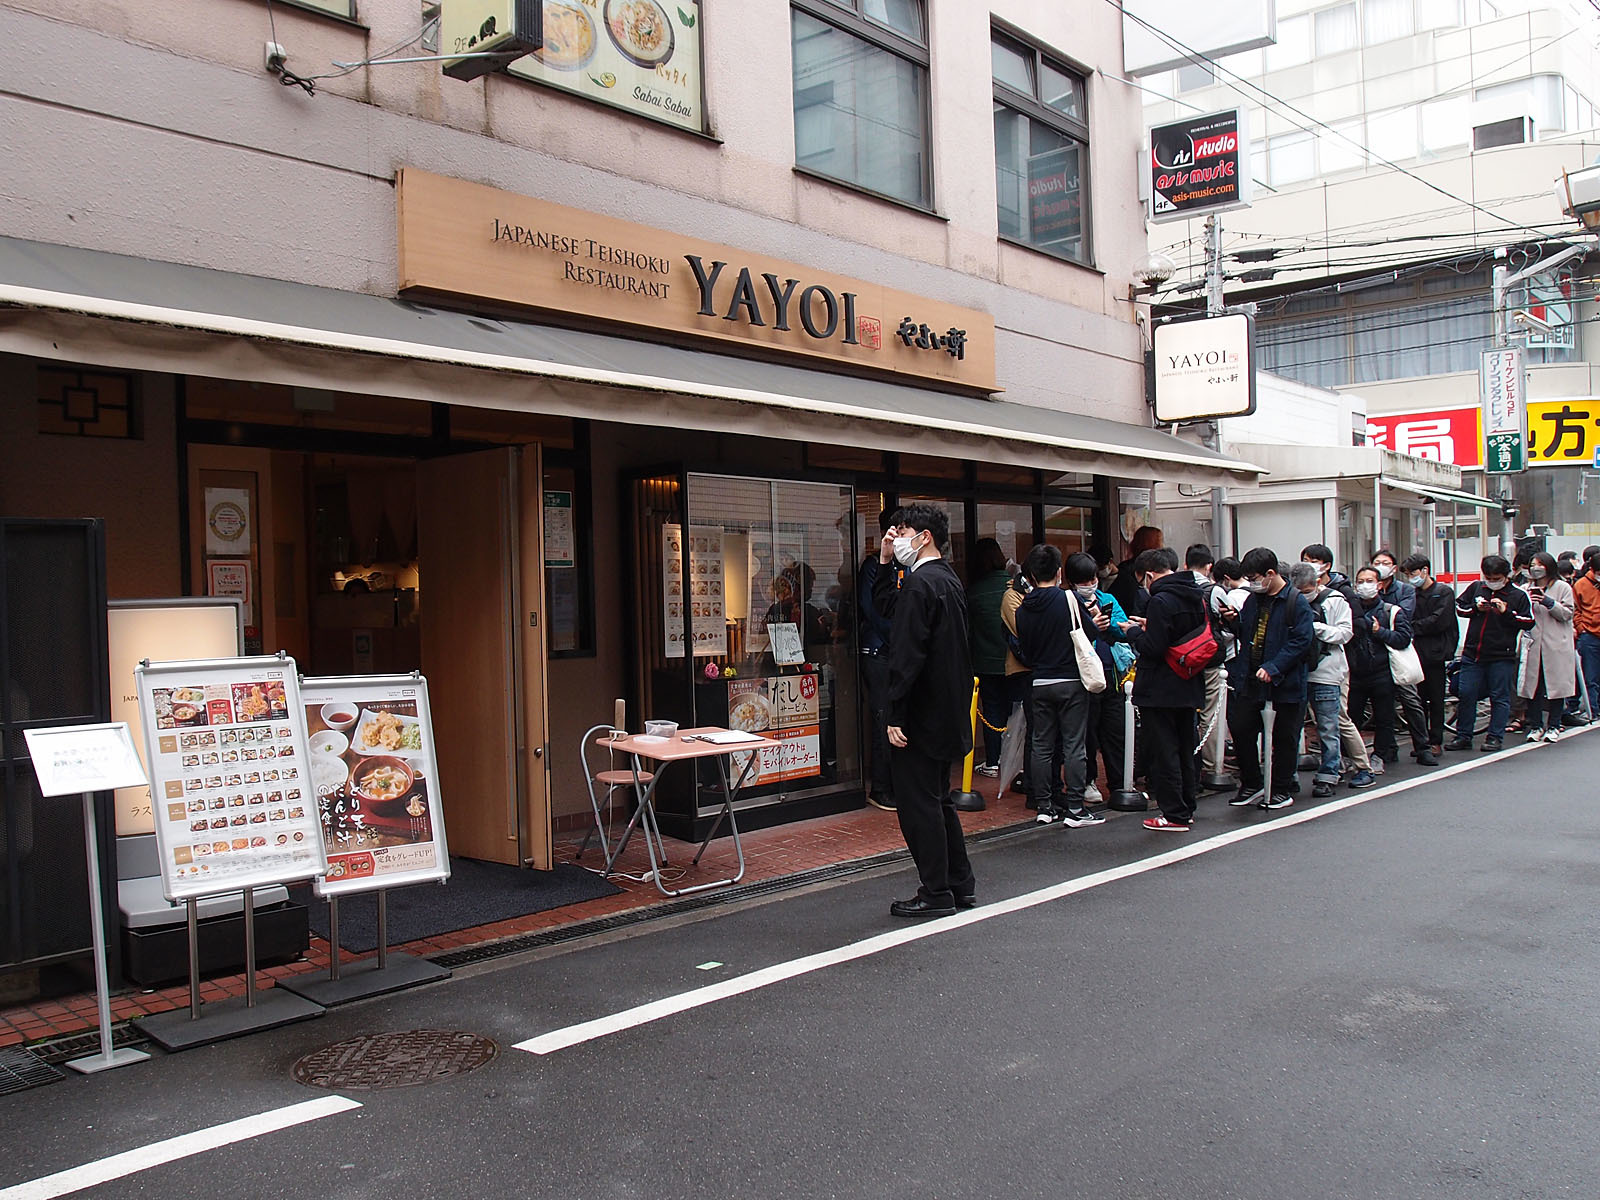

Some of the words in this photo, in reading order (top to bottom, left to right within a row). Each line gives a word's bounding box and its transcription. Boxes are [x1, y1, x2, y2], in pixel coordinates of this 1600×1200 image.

[632, 86, 662, 107] Sabai
[663, 99, 692, 117] Sabai
[1196, 135, 1235, 157] studio
[1190, 160, 1235, 184] music
[1155, 200, 1169, 209] 4F
[1172, 183, 1235, 203] asis-music.com
[491, 218, 579, 256] JAPANESE
[584, 238, 670, 275] TEISHOKU
[563, 260, 670, 299] RESTAURANT
[684, 254, 860, 345] YAYOI
[896, 316, 968, 361] やよい軒
[1169, 350, 1227, 369] YAYOI
[1366, 418, 1455, 466] 局
[1497, 442, 1512, 471] 本通り
[771, 680, 799, 705] だし
[780, 701, 808, 713] サービス
[331, 781, 353, 848] だんご汁
